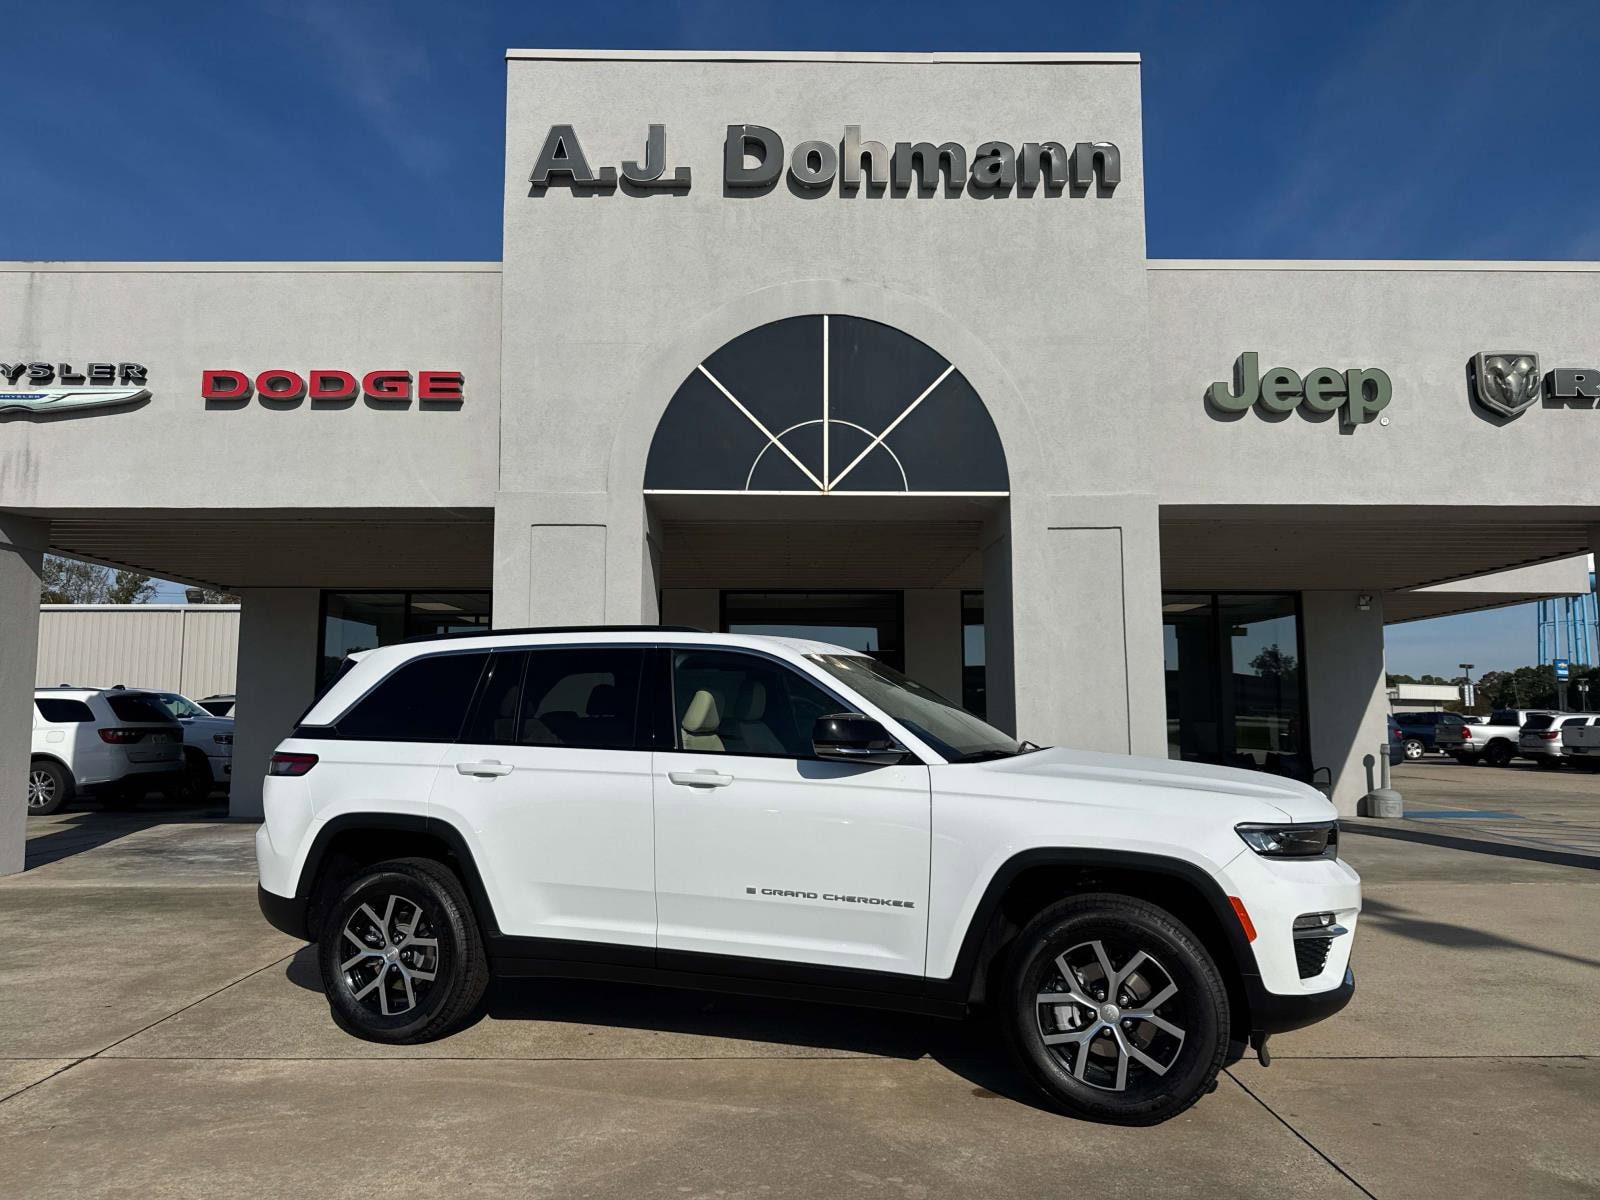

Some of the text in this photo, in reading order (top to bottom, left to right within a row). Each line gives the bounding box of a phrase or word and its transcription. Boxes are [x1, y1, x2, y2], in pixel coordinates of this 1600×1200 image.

[528, 124, 1121, 191] A.J. Dohmann
[201, 370, 463, 402] DODGE
[1207, 352, 1393, 426] Jeep
[761, 888, 915, 908] GRAND CHEROKEE
